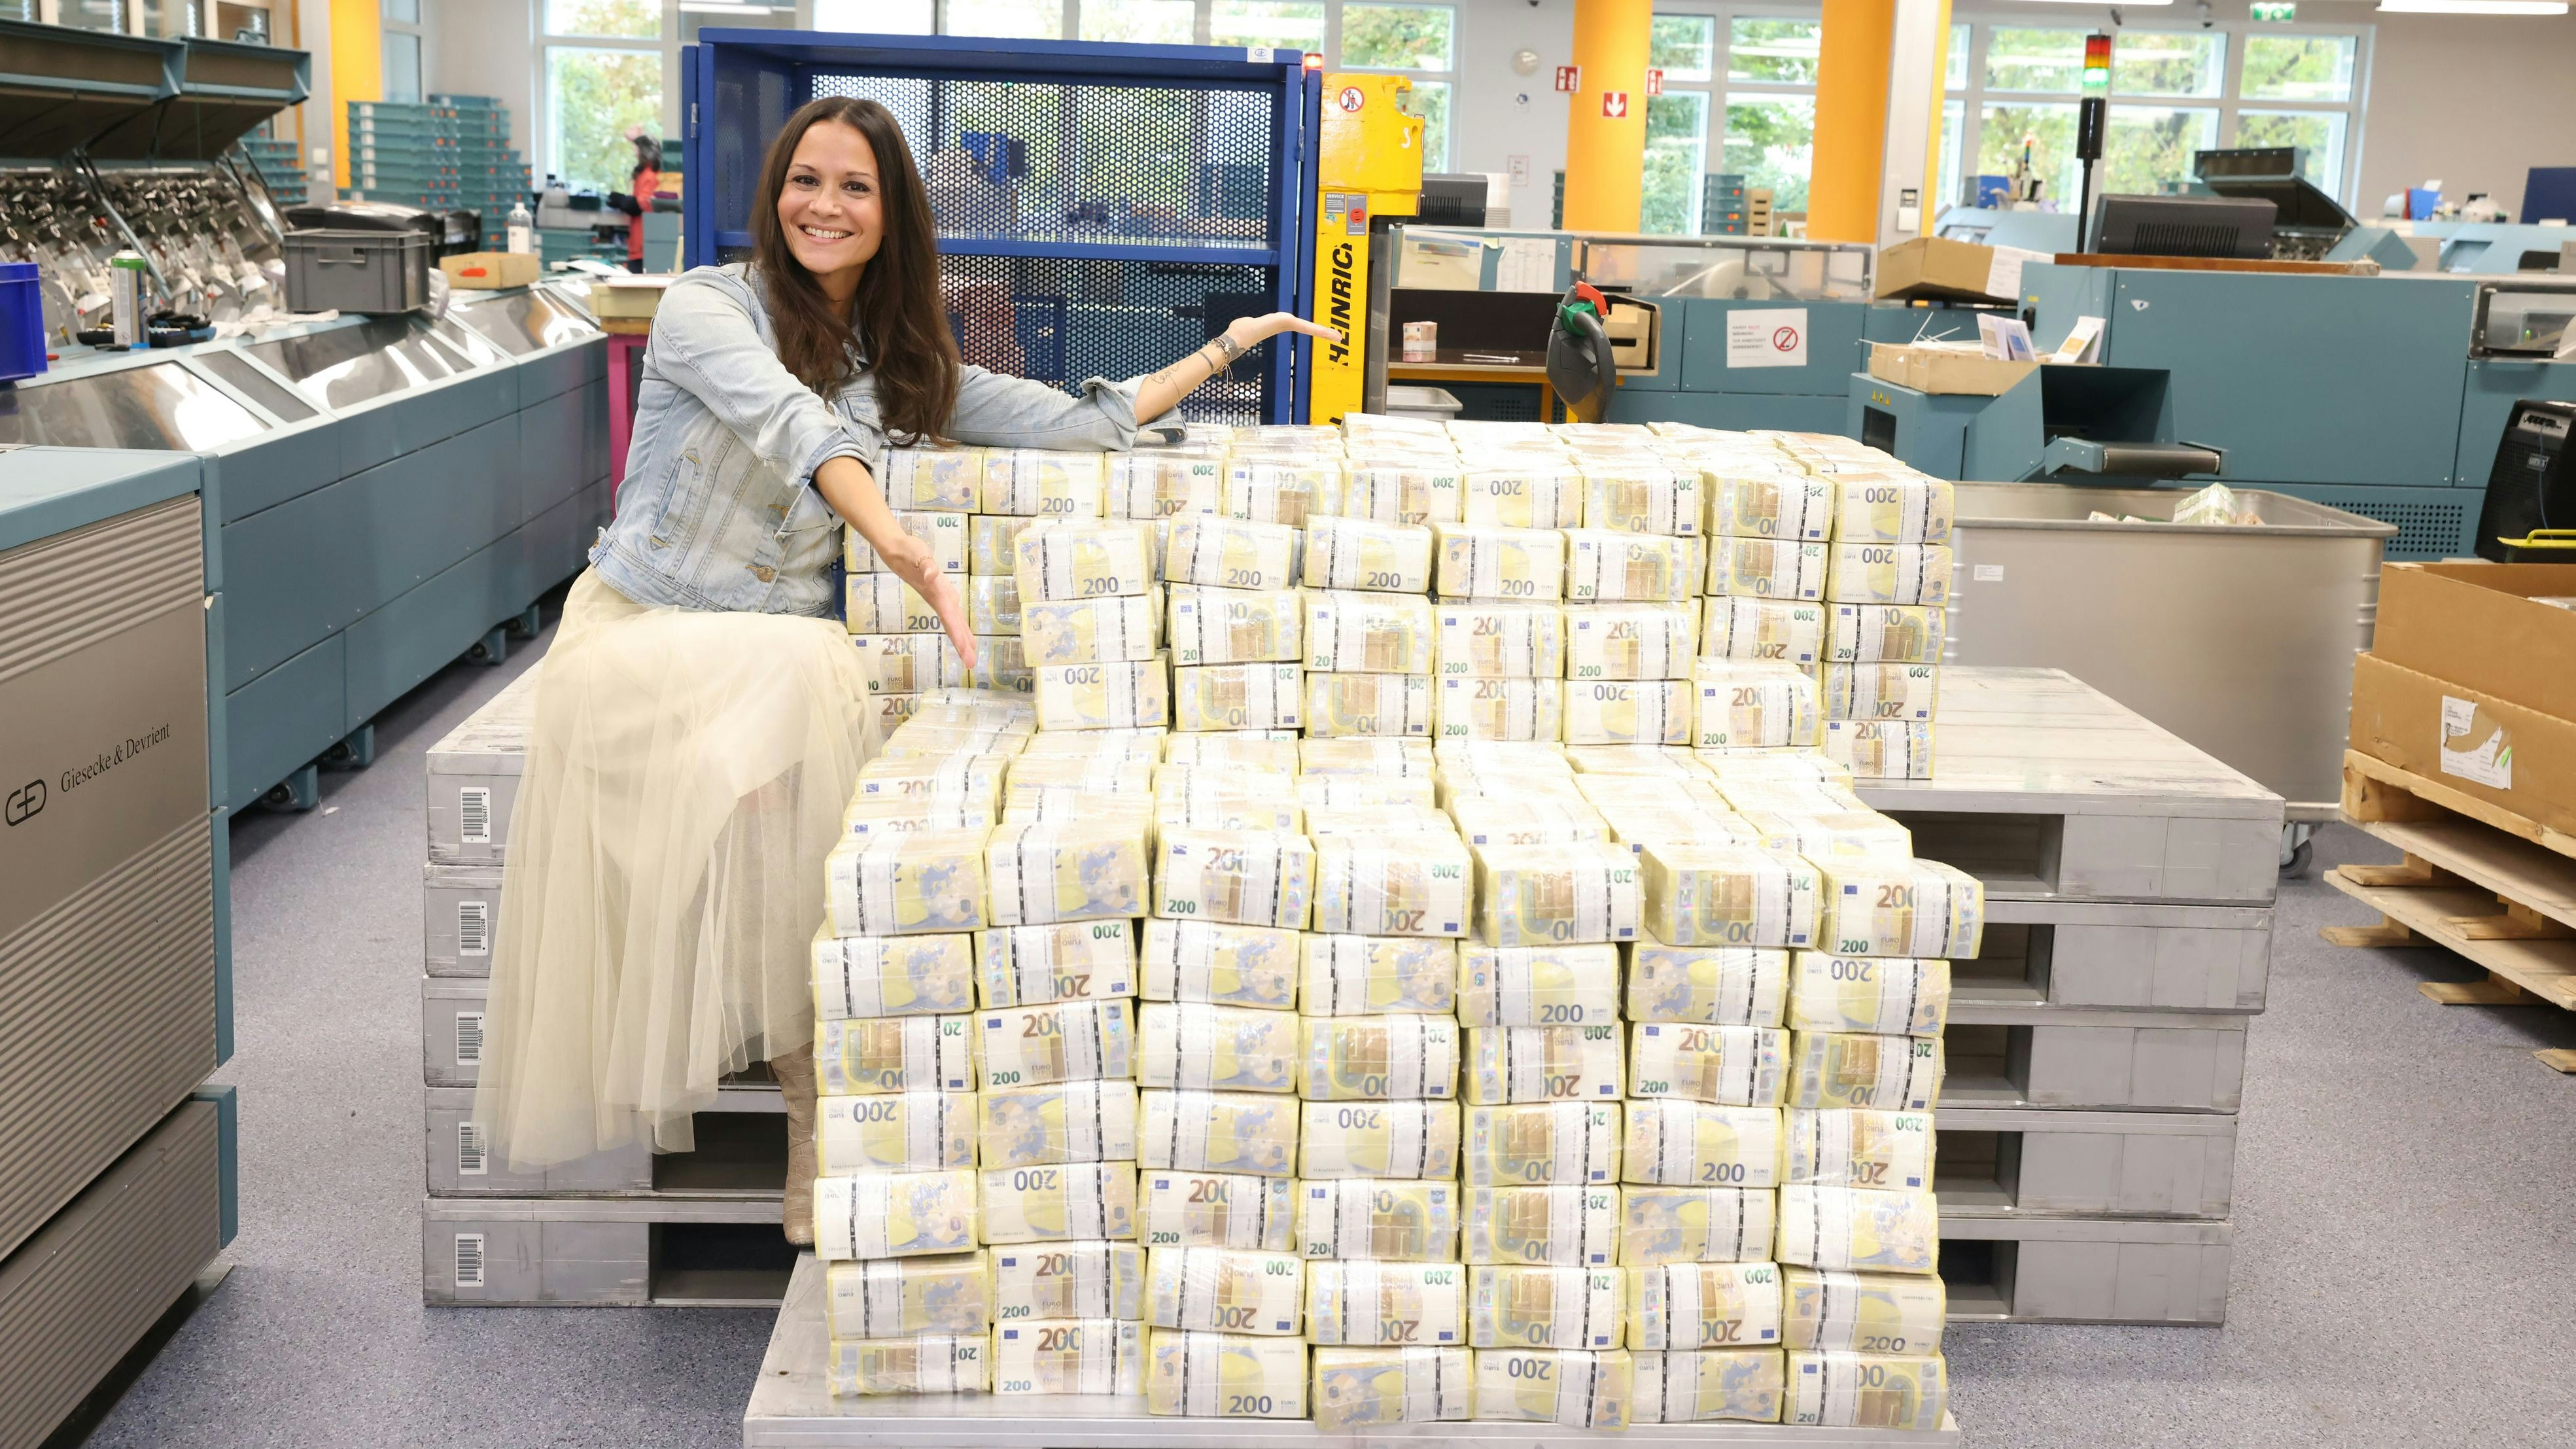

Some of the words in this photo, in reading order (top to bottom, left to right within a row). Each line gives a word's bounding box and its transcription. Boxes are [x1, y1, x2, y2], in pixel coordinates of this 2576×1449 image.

[1329, 243, 1353, 366] HEINRIC
[1192, 464, 1213, 476] 200
[1433, 477, 1454, 488] 200
[1490, 481, 1522, 495] 200
[1679, 480, 1692, 490] 20
[1865, 488, 1896, 503] 200
[1042, 498, 1075, 513] 200
[937, 517, 958, 527] 200
[1805, 546, 1819, 557] 20
[1862, 548, 1894, 563] 200
[1227, 568, 1262, 585] 200
[1367, 572, 1401, 588] 200
[1084, 578, 1119, 594] 200
[1501, 580, 1535, 596] 200
[1578, 585, 1592, 596] 20
[908, 616, 941, 630] 200
[1794, 610, 1815, 621] 200
[1183, 650, 1197, 661] 20
[1279, 668, 1293, 680] 20
[1445, 663, 1468, 673] 200
[1578, 665, 1601, 676] 200
[1909, 667, 1930, 678] 200
[1064, 668, 1099, 685] 200
[1594, 684, 1628, 701] 200
[1445, 724, 1468, 735] 200
[1704, 733, 1727, 744] 200
[61, 754, 111, 792] Giesecke
[114, 744, 123, 765] &
[126, 723, 170, 759] Devrient
[1433, 864, 1460, 879] 200
[1614, 869, 1631, 883] 20
[1793, 875, 1810, 891] 20
[1168, 899, 1196, 914] 200
[1093, 924, 1121, 939] 200
[1841, 939, 1868, 952] 200
[1831, 960, 1871, 981] 200
[1540, 1004, 1583, 1022] 200
[944, 1022, 961, 1037] 20
[1584, 1026, 1612, 1041] 200
[1917, 1043, 1932, 1058] 20
[992, 1072, 1020, 1085] 200
[1640, 1081, 1669, 1093] 200
[853, 1101, 896, 1123] 200
[1339, 1108, 1380, 1129] 200
[1896, 1117, 1923, 1131] 200
[1702, 1162, 1745, 1182] 200
[1014, 1170, 1056, 1191] 200
[1590, 1195, 1608, 1210] 20
[1151, 1232, 1179, 1244] 200
[1266, 1261, 1294, 1276] 200
[1745, 1268, 1772, 1283] 200
[1424, 1270, 1452, 1285] 200
[1593, 1275, 1610, 1290] 20
[1002, 1305, 1030, 1318] 200
[1038, 1328, 1079, 1352] 200
[1862, 1336, 1905, 1352] 200
[1508, 1358, 1551, 1379] 200
[1003, 1380, 1032, 1392] 200
[1228, 1395, 1272, 1414] 200
